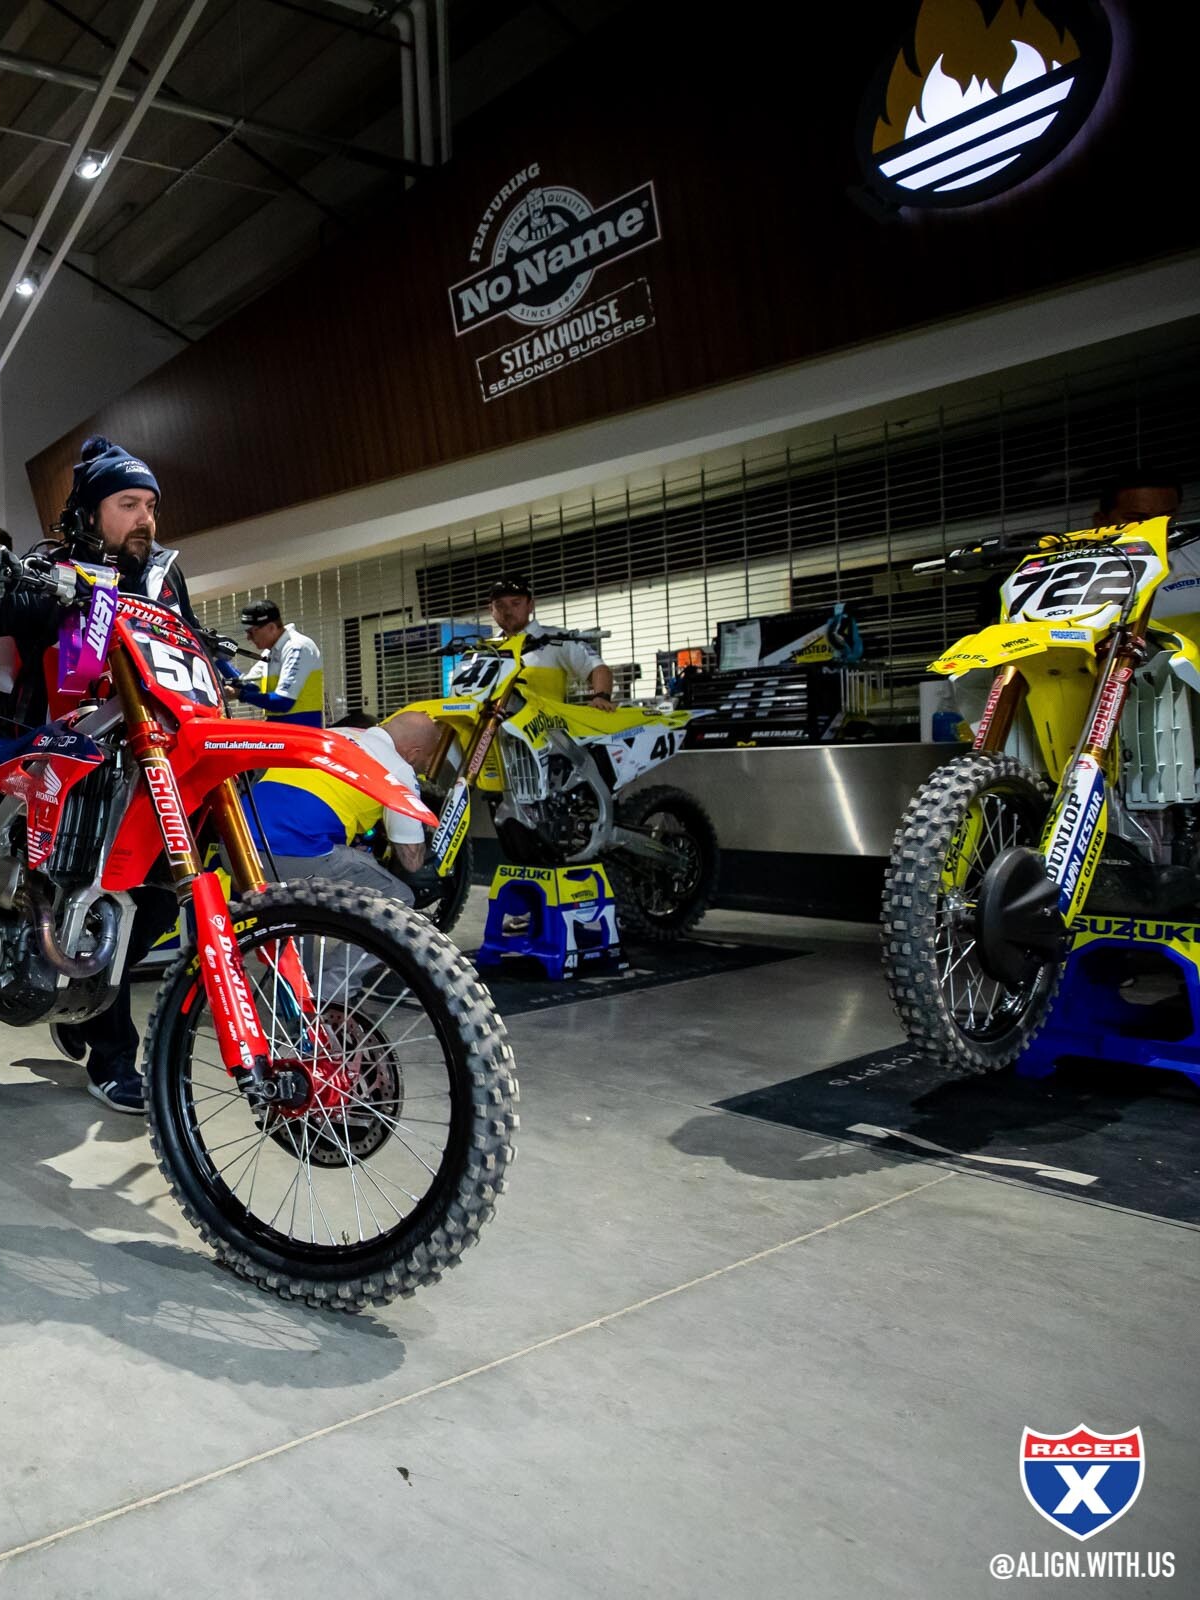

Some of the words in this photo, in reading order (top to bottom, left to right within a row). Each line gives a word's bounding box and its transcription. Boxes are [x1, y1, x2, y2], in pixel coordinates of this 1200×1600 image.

[469, 162, 541, 263] FEATURING
[548, 193, 586, 216] QUALITY
[458, 275, 512, 322] No
[513, 207, 645, 295] Name
[519, 306, 551, 319] SINCE
[557, 281, 583, 308] 1970
[489, 352, 564, 394] SEASONED
[569, 314, 646, 358] BURGERS
[500, 299, 622, 373] STEAKHOUSE
[1056, 547, 1116, 560] MONSTER
[1008, 558, 1148, 618] 722
[150, 639, 219, 707] 54
[453, 658, 504, 689] 41
[1087, 678, 1120, 747] NOLEEN
[204, 741, 285, 750] StormLakeHonda.com
[650, 733, 675, 761] 41
[35, 791, 59, 806] HONDA
[144, 766, 192, 854] SHOWA
[431, 799, 455, 851] DUNLOP
[1077, 790, 1104, 856] ECSTAR
[1046, 792, 1082, 882] DUNLOP
[1084, 829, 1104, 878] GALFER
[500, 866, 551, 881] SUZUKI
[218, 934, 260, 1039] DUNLOP
